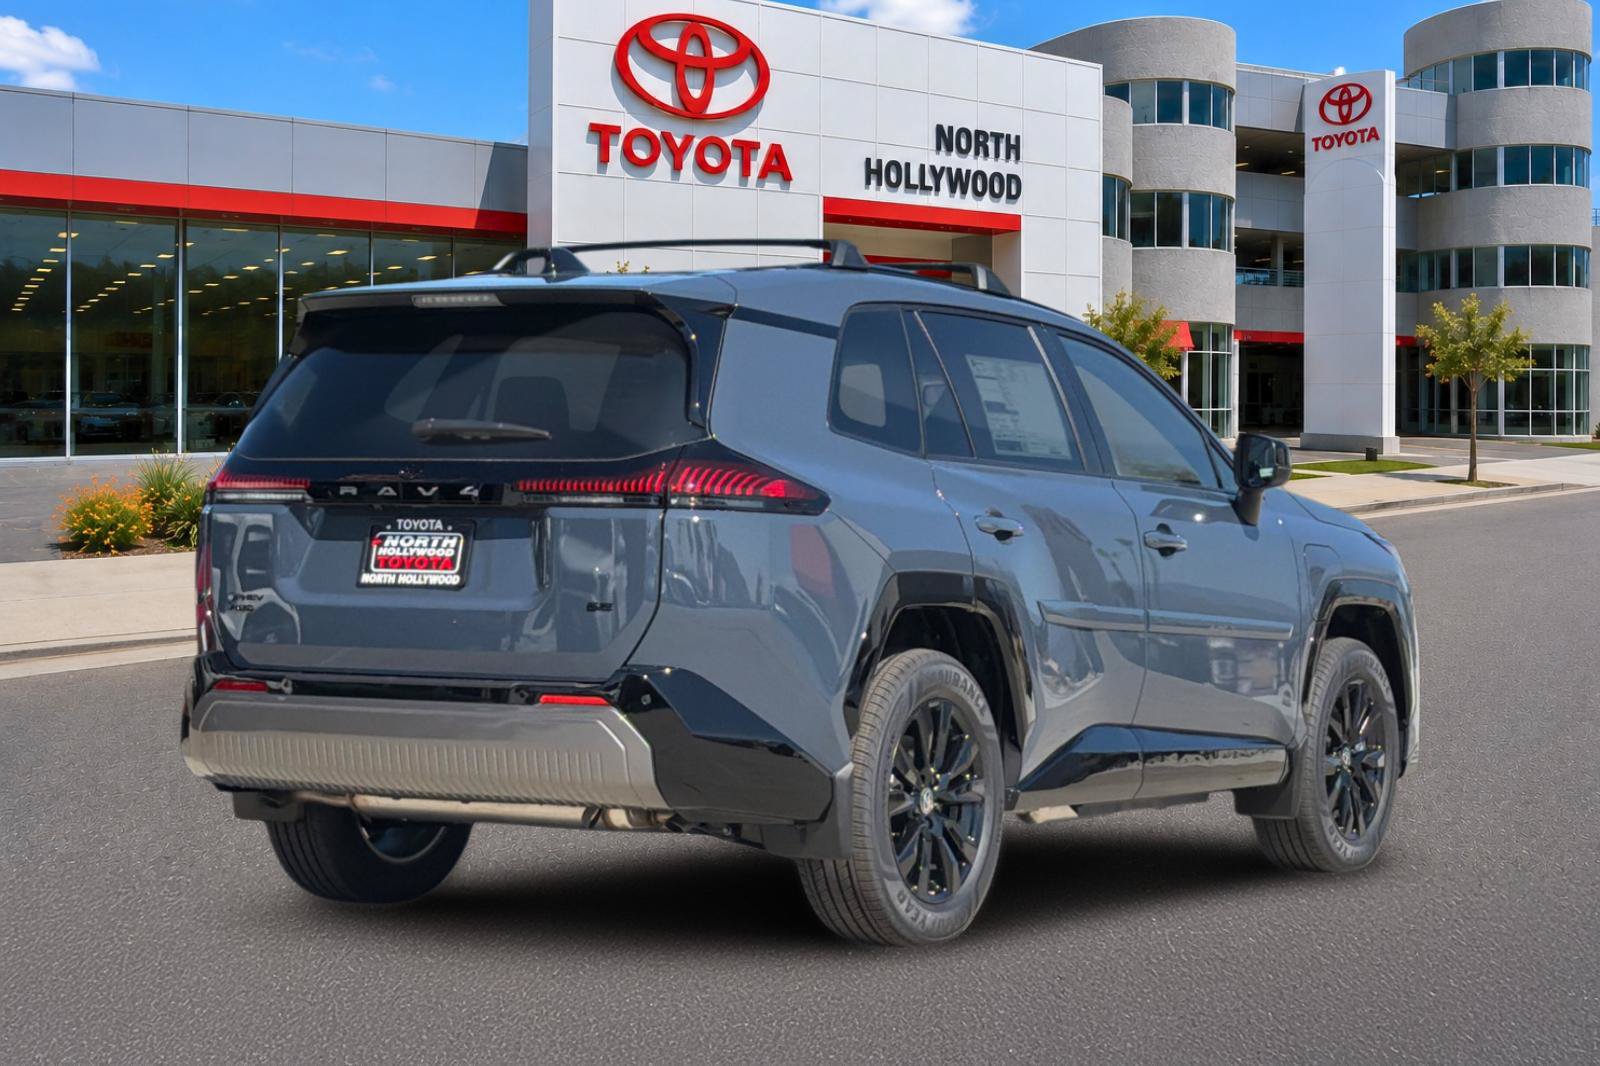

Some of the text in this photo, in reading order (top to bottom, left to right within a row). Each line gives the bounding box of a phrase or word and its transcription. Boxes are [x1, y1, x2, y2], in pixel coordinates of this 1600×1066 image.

[935, 124, 1021, 161] NORTH
[1312, 126, 1380, 152] TOYOTA
[588, 123, 793, 181] TOYOTA
[865, 157, 1022, 202] HOLLYWOOD
[339, 485, 480, 497] RAV4
[396, 519, 443, 531] TOYOTA
[384, 536, 458, 548] NORTH
[377, 547, 455, 557] HOLLYWOOD
[378, 557, 452, 569] TOYOTA
[361, 573, 460, 586] NORTH HOLLYWOOD
